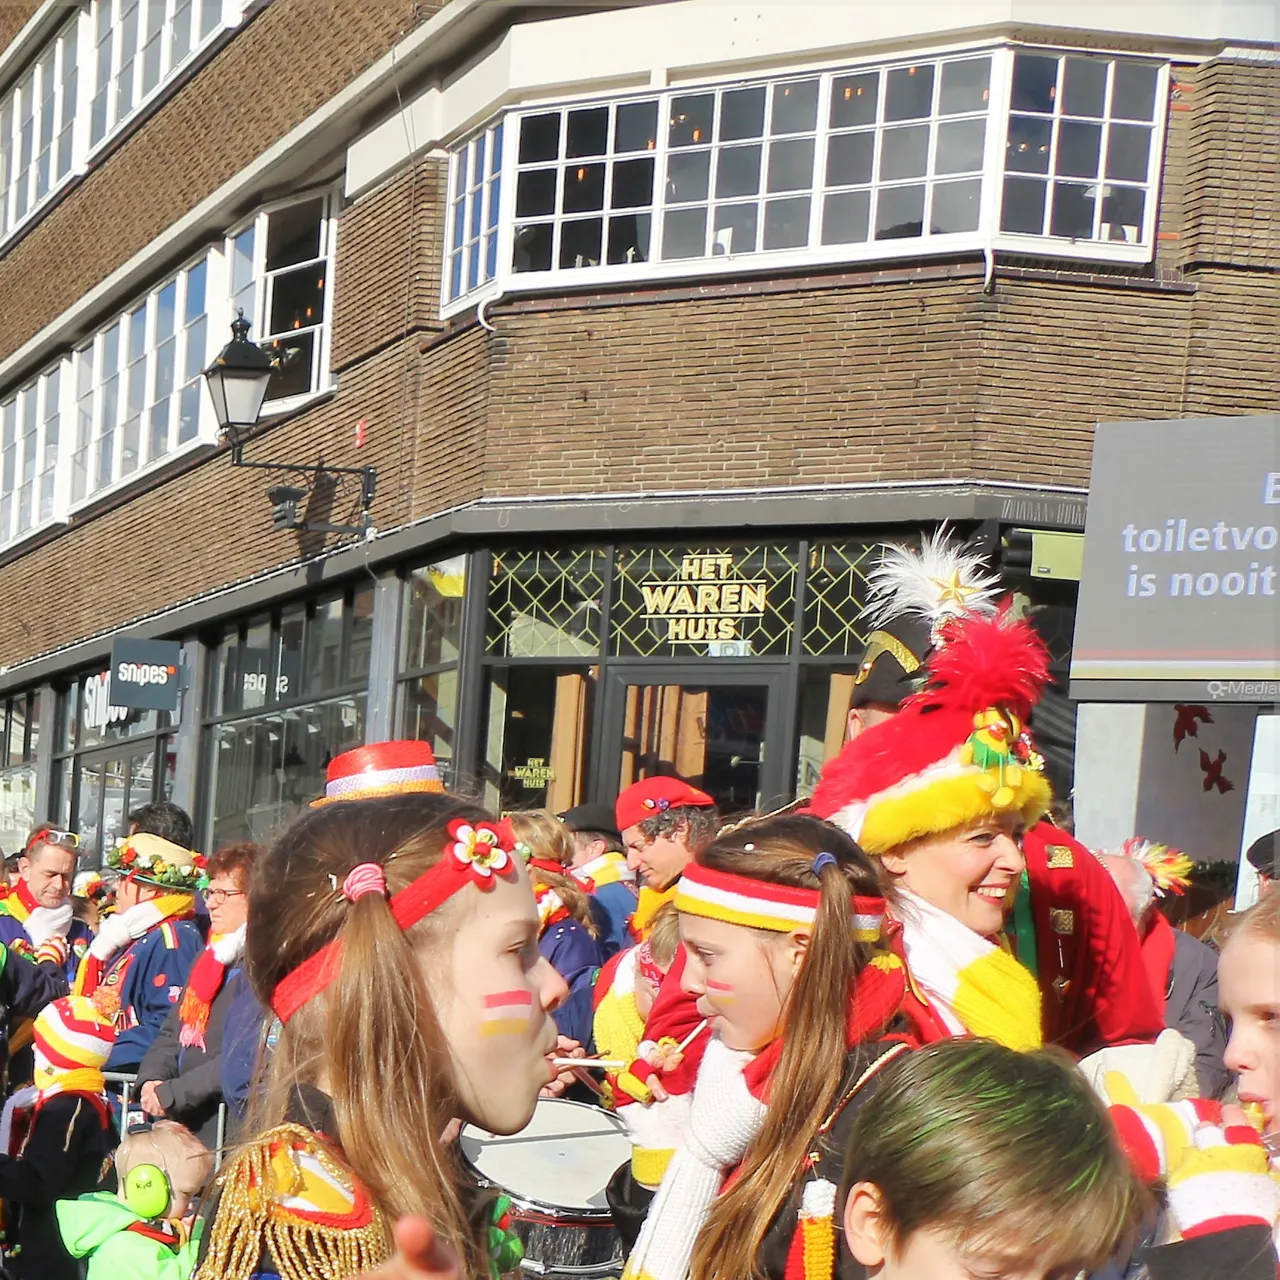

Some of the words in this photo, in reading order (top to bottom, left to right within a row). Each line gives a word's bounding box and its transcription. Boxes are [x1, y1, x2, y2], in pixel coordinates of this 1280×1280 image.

[681, 557, 733, 580] HET
[1127, 564, 1156, 597] is
[1170, 561, 1277, 597] nooit
[642, 584, 767, 614] WAREN
[668, 618, 736, 640] HUIS
[118, 662, 169, 686] snipes
[515, 767, 554, 779] WAREN
[527, 758, 544, 767] HET
[523, 779, 545, 788] HUIS
[136, 1180, 152, 1190] kid
